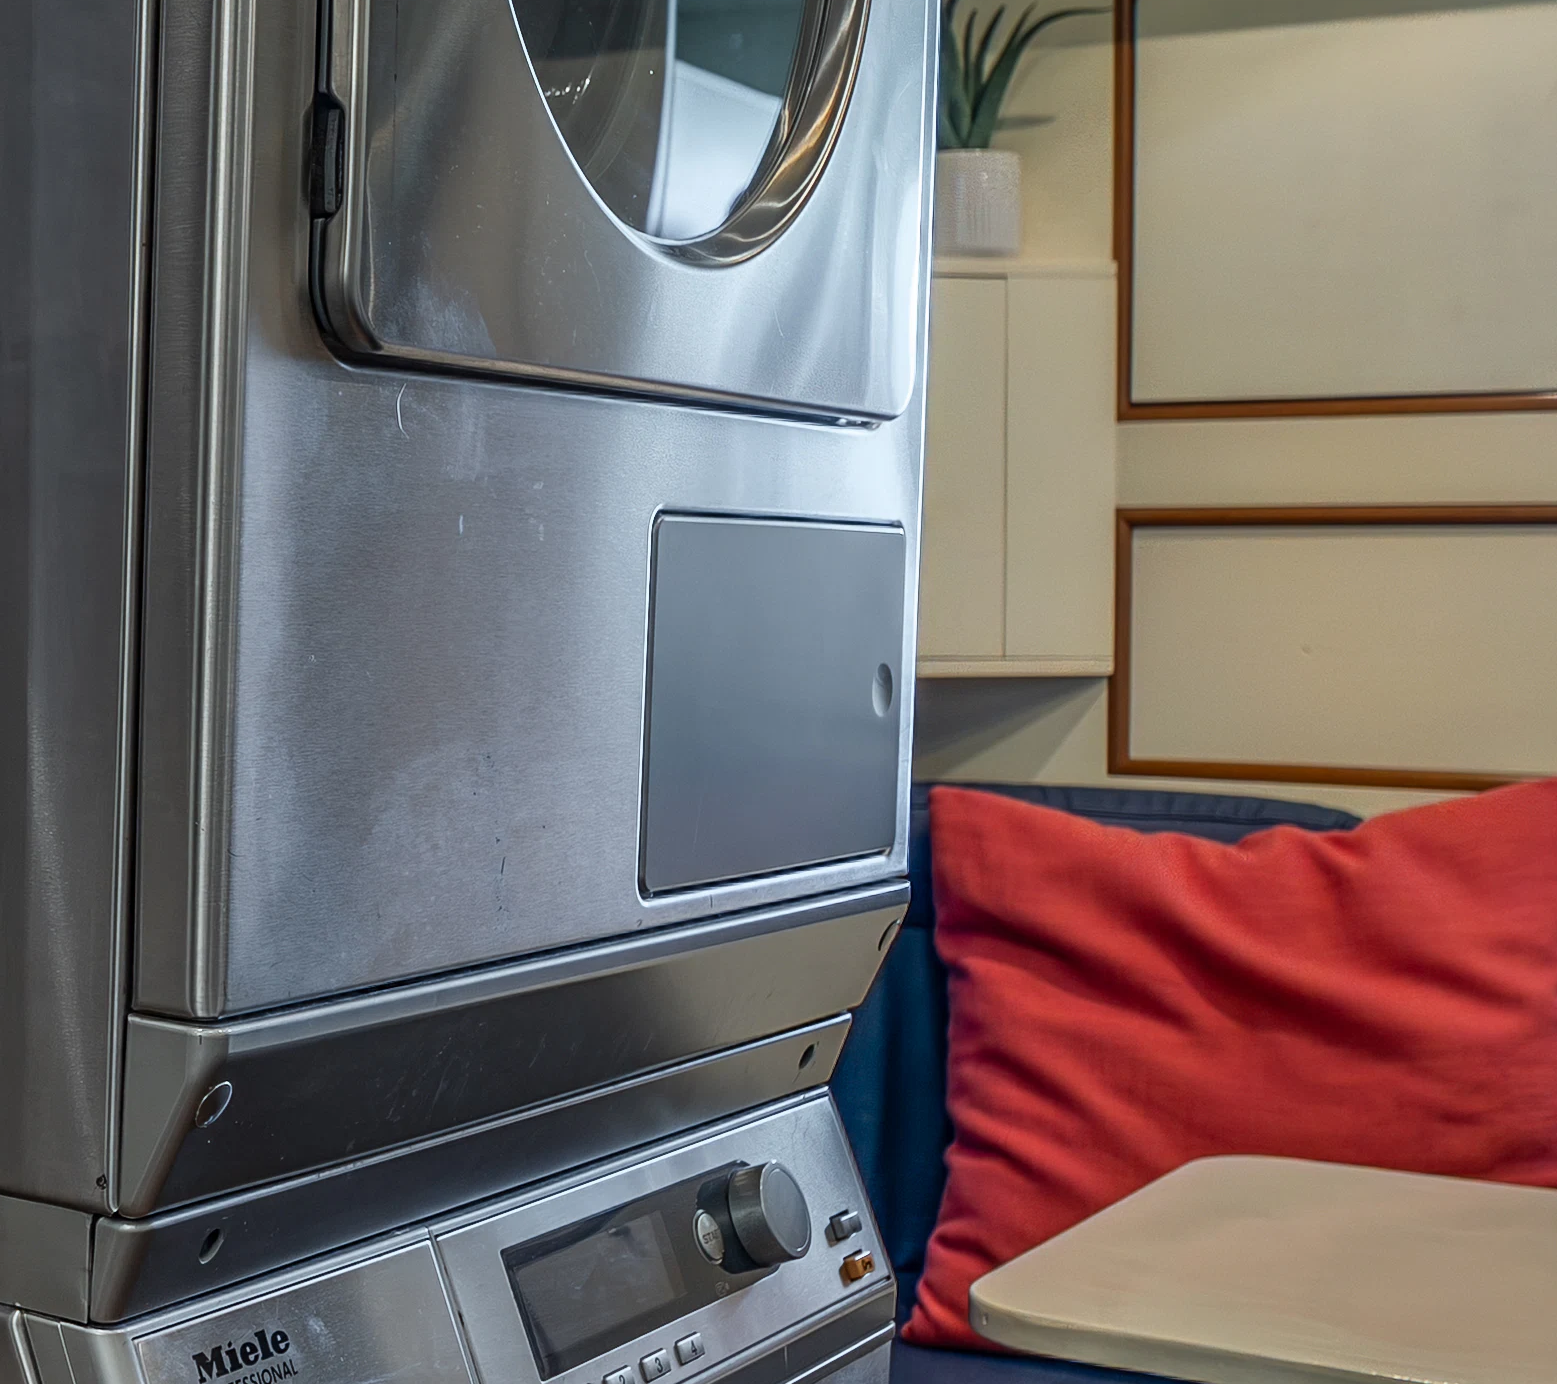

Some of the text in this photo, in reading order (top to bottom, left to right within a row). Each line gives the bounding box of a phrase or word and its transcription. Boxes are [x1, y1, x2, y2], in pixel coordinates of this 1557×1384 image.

[191, 1328, 290, 1384] Miele
[690, 1339, 698, 1356] 4
[654, 1356, 664, 1374] 3
